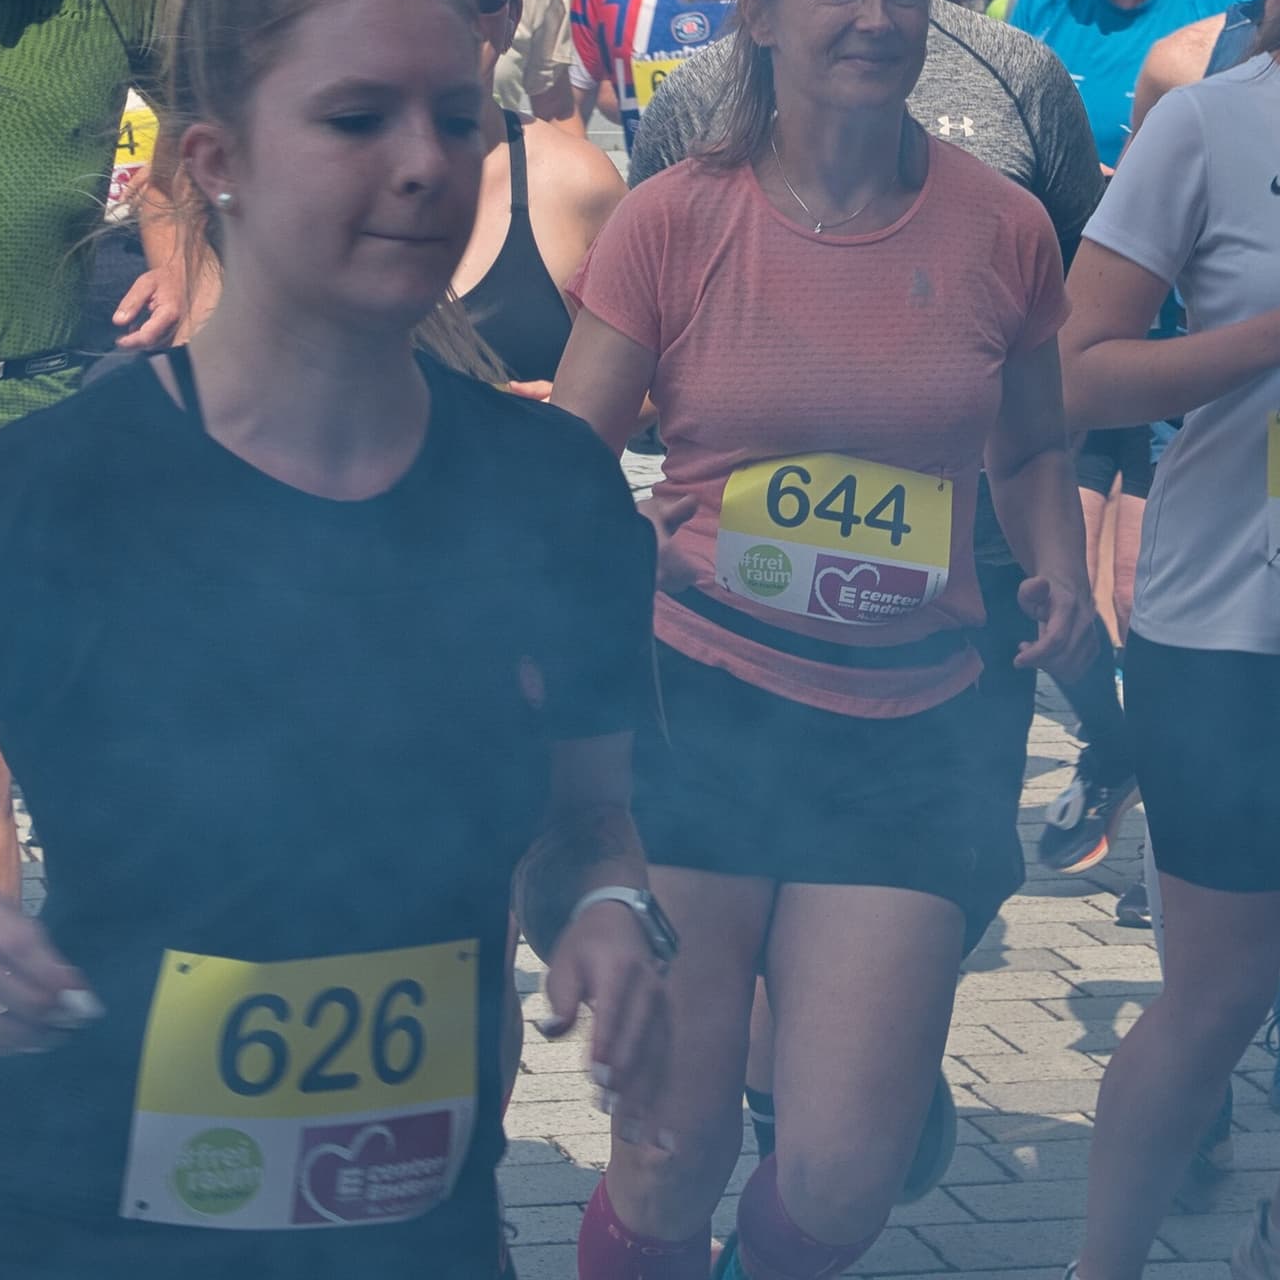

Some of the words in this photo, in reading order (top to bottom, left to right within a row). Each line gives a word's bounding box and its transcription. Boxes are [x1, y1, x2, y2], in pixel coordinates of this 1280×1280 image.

[766, 464, 911, 547] 644
[746, 568, 792, 583] raum
[860, 589, 920, 606] center
[218, 978, 426, 1097] 626
